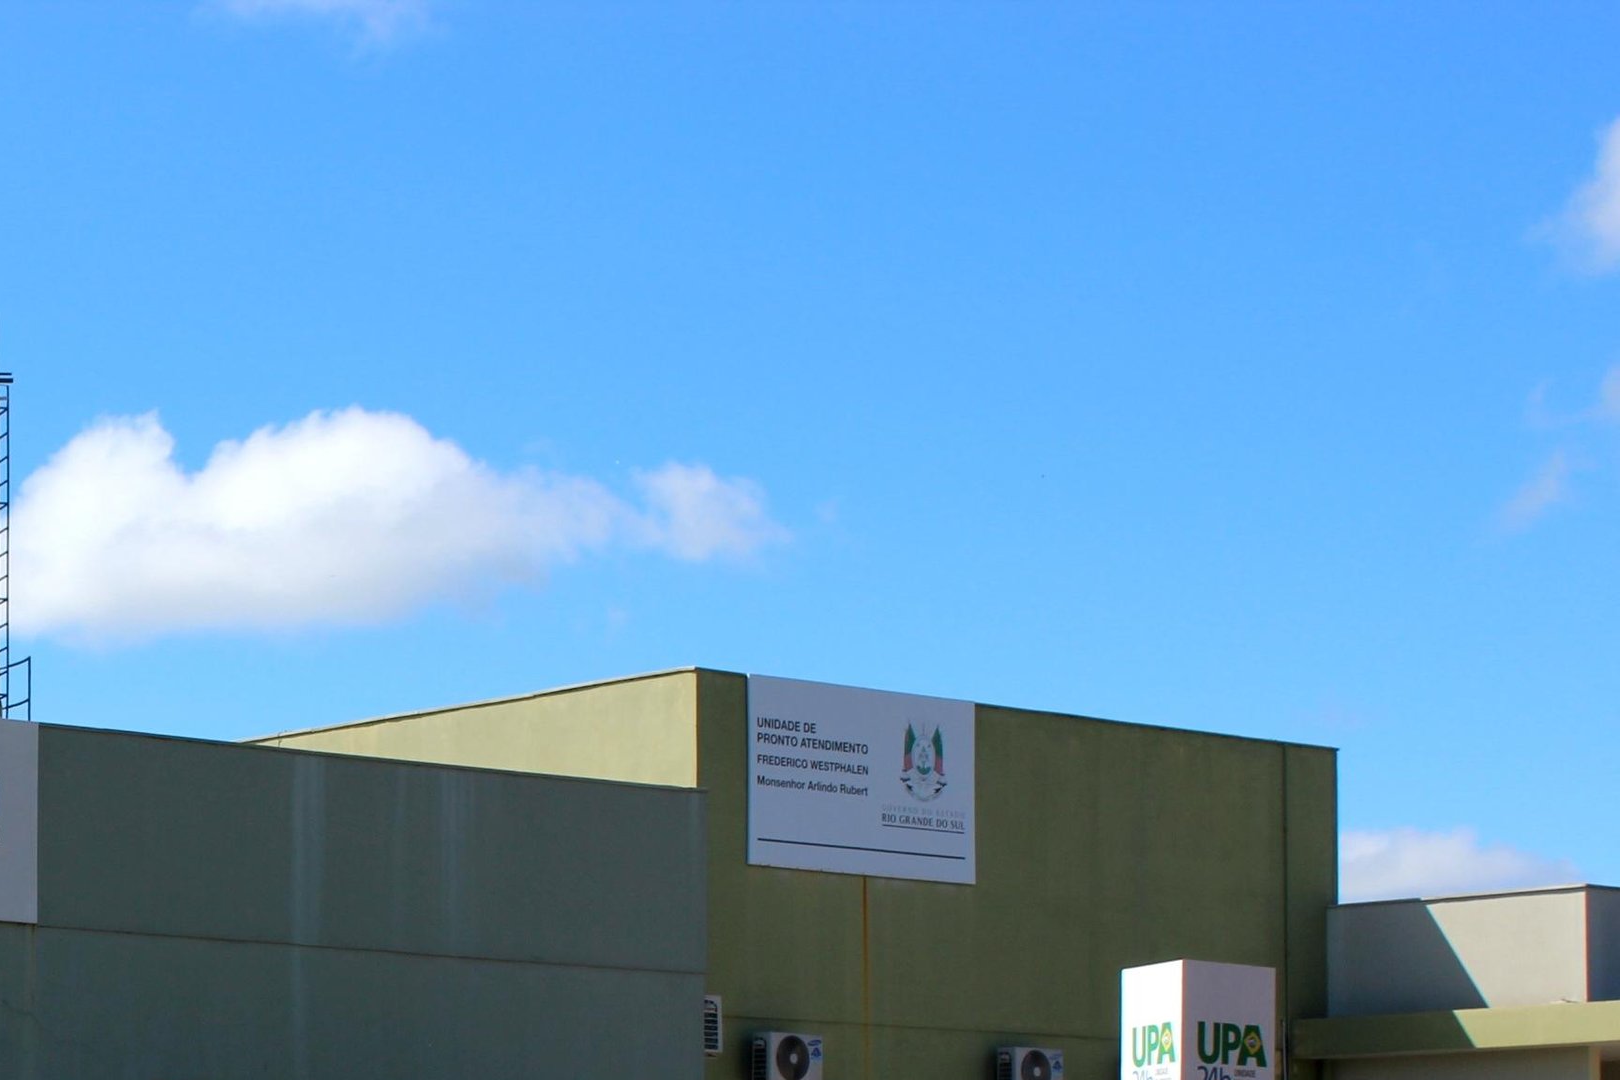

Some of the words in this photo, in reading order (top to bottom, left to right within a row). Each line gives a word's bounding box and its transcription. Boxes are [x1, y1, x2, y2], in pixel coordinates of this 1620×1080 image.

[756, 717, 801, 732] UNIDADE
[803, 722, 817, 734] DE
[756, 733, 798, 747] PRONTO
[800, 738, 869, 755] ATENDIMENTO
[756, 754, 808, 769] FREDERICO
[811, 760, 869, 775] WESTPHALEN
[756, 775, 805, 790] Monsenhor
[808, 780, 838, 793] Arlindo
[840, 784, 869, 796] Rubert
[881, 813, 897, 823] RIO
[899, 815, 933, 827] GRANDE
[936, 819, 947, 828] DO
[950, 820, 965, 830] SUL
[1132, 1022, 1176, 1068] UPA
[1197, 1021, 1267, 1067] UPA
